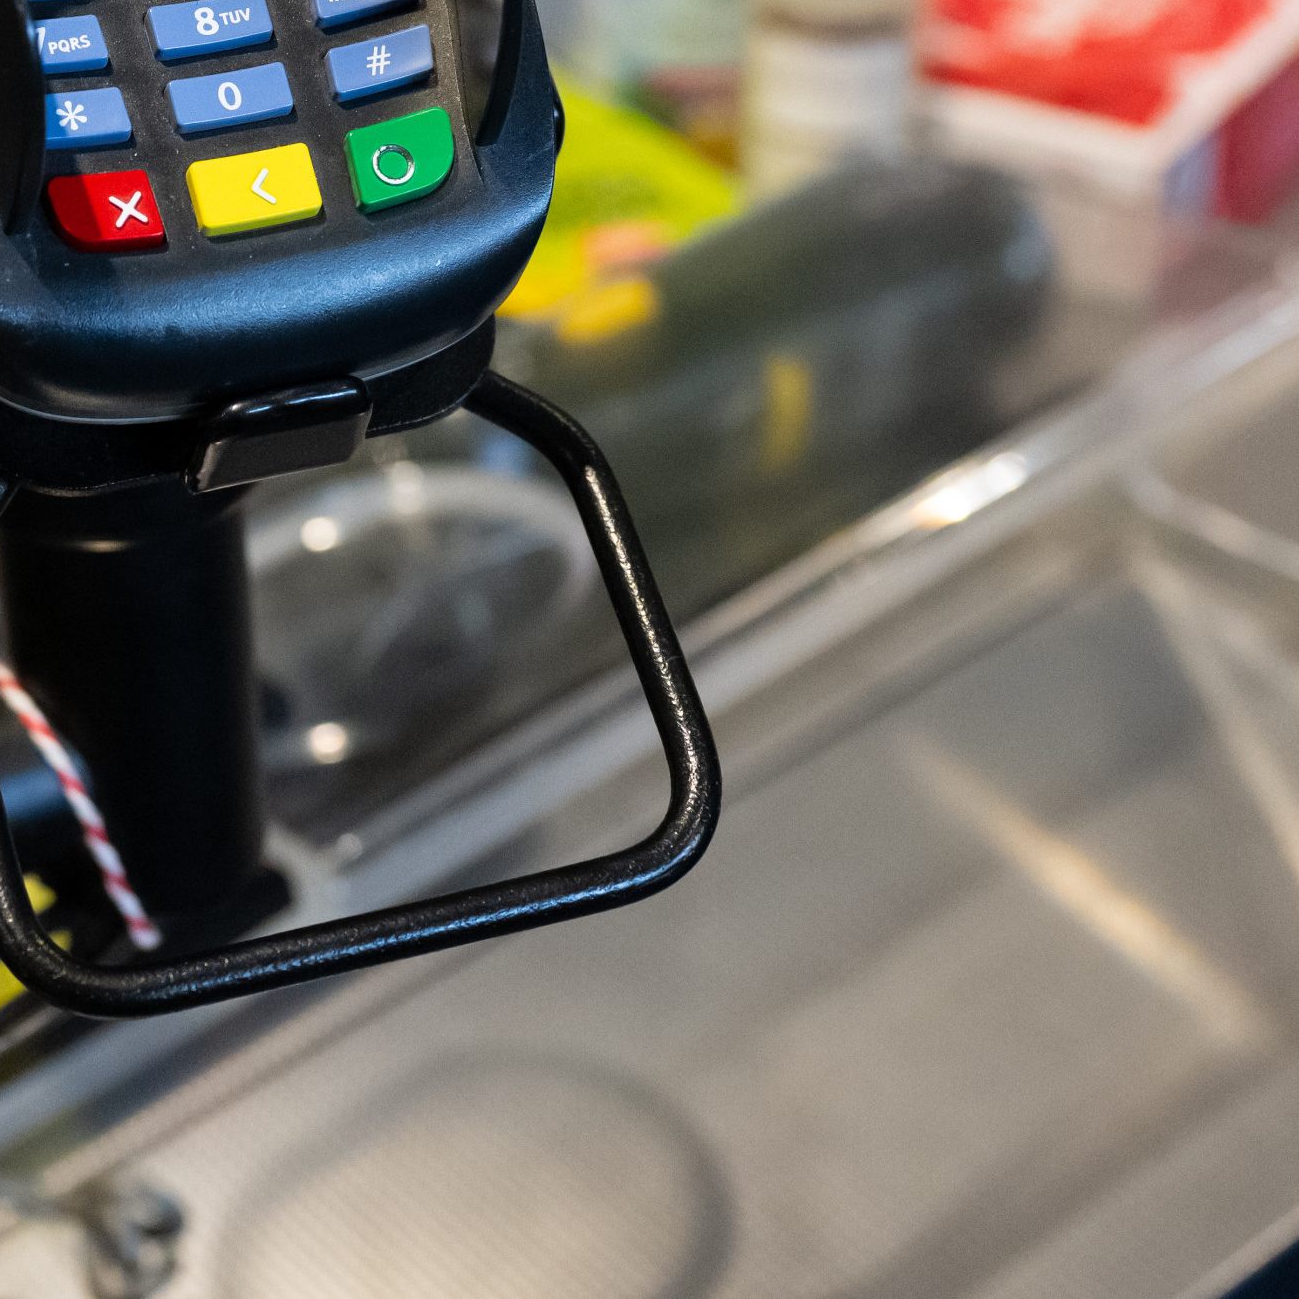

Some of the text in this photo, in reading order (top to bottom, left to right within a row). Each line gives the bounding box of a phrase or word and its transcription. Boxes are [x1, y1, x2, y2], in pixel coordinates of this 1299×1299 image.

[194, 7, 251, 36] 8 TUV
[47, 34, 92, 55] PQRS
[217, 81, 243, 111] 0
